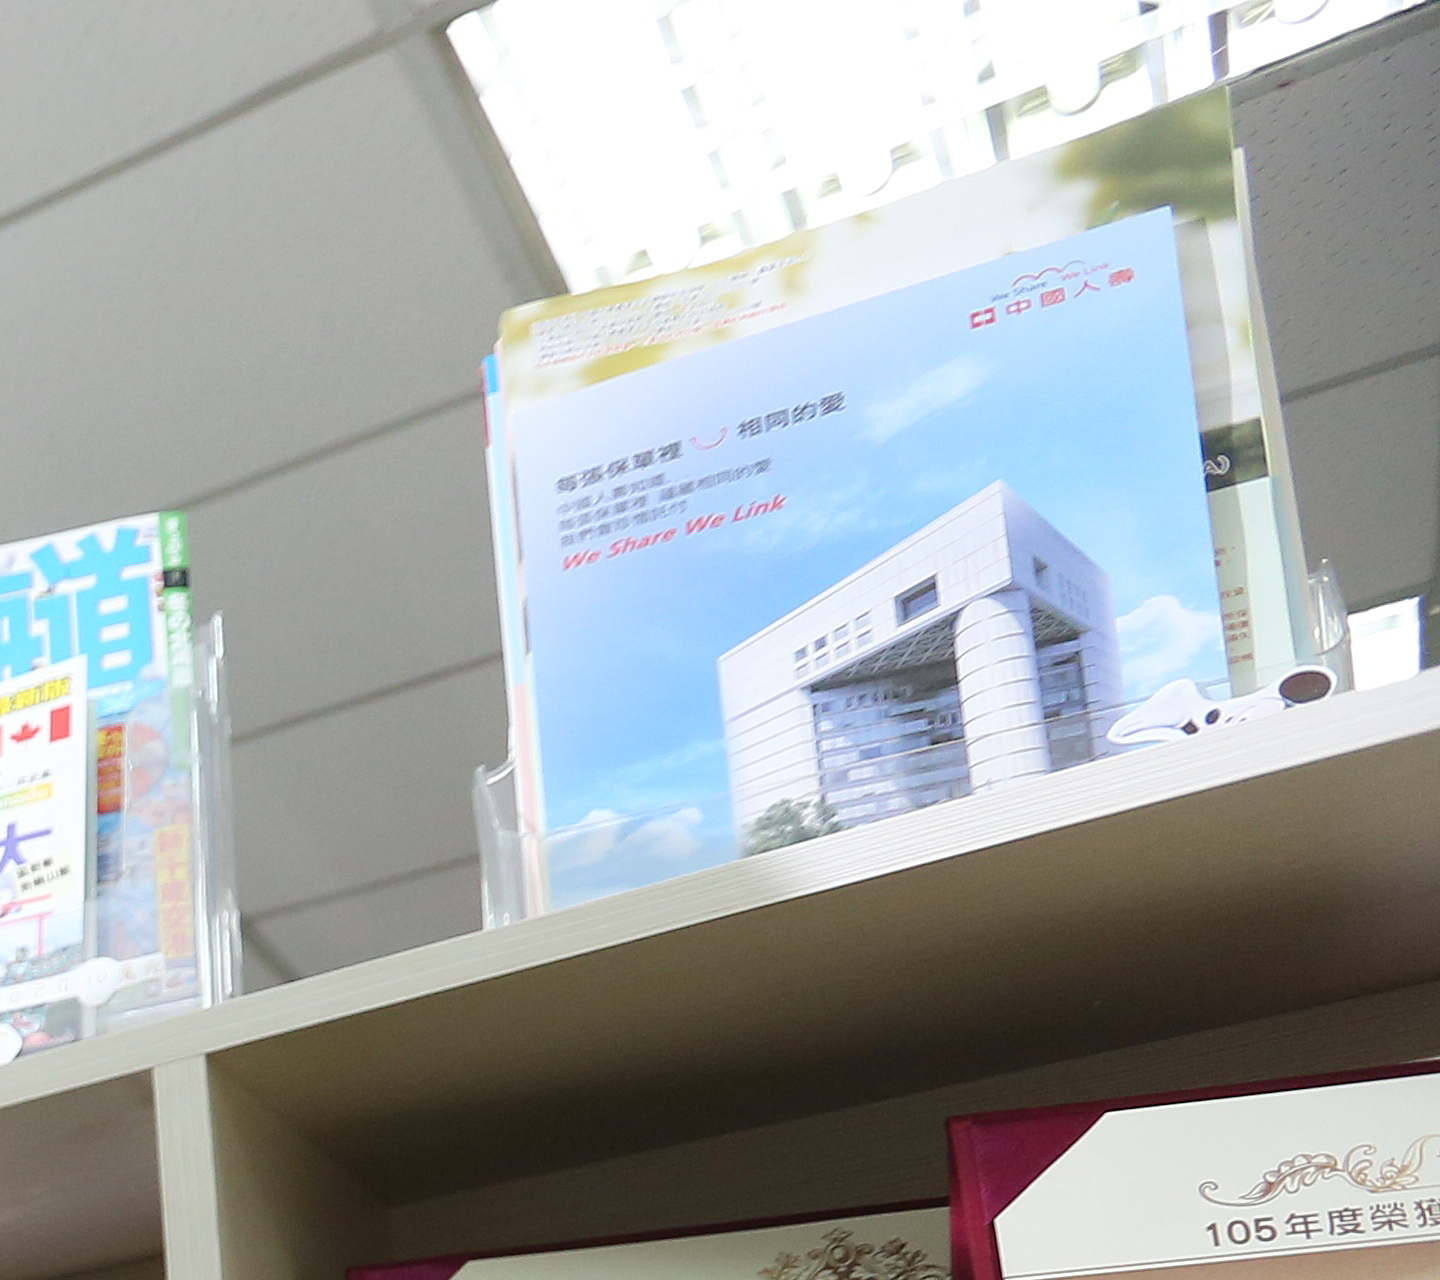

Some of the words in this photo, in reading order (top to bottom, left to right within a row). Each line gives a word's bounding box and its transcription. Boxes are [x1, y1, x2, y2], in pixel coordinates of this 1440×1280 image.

[563, 549, 601, 571] We
[608, 527, 678, 559] Share
[686, 514, 726, 536] We
[732, 494, 788, 524] Link
